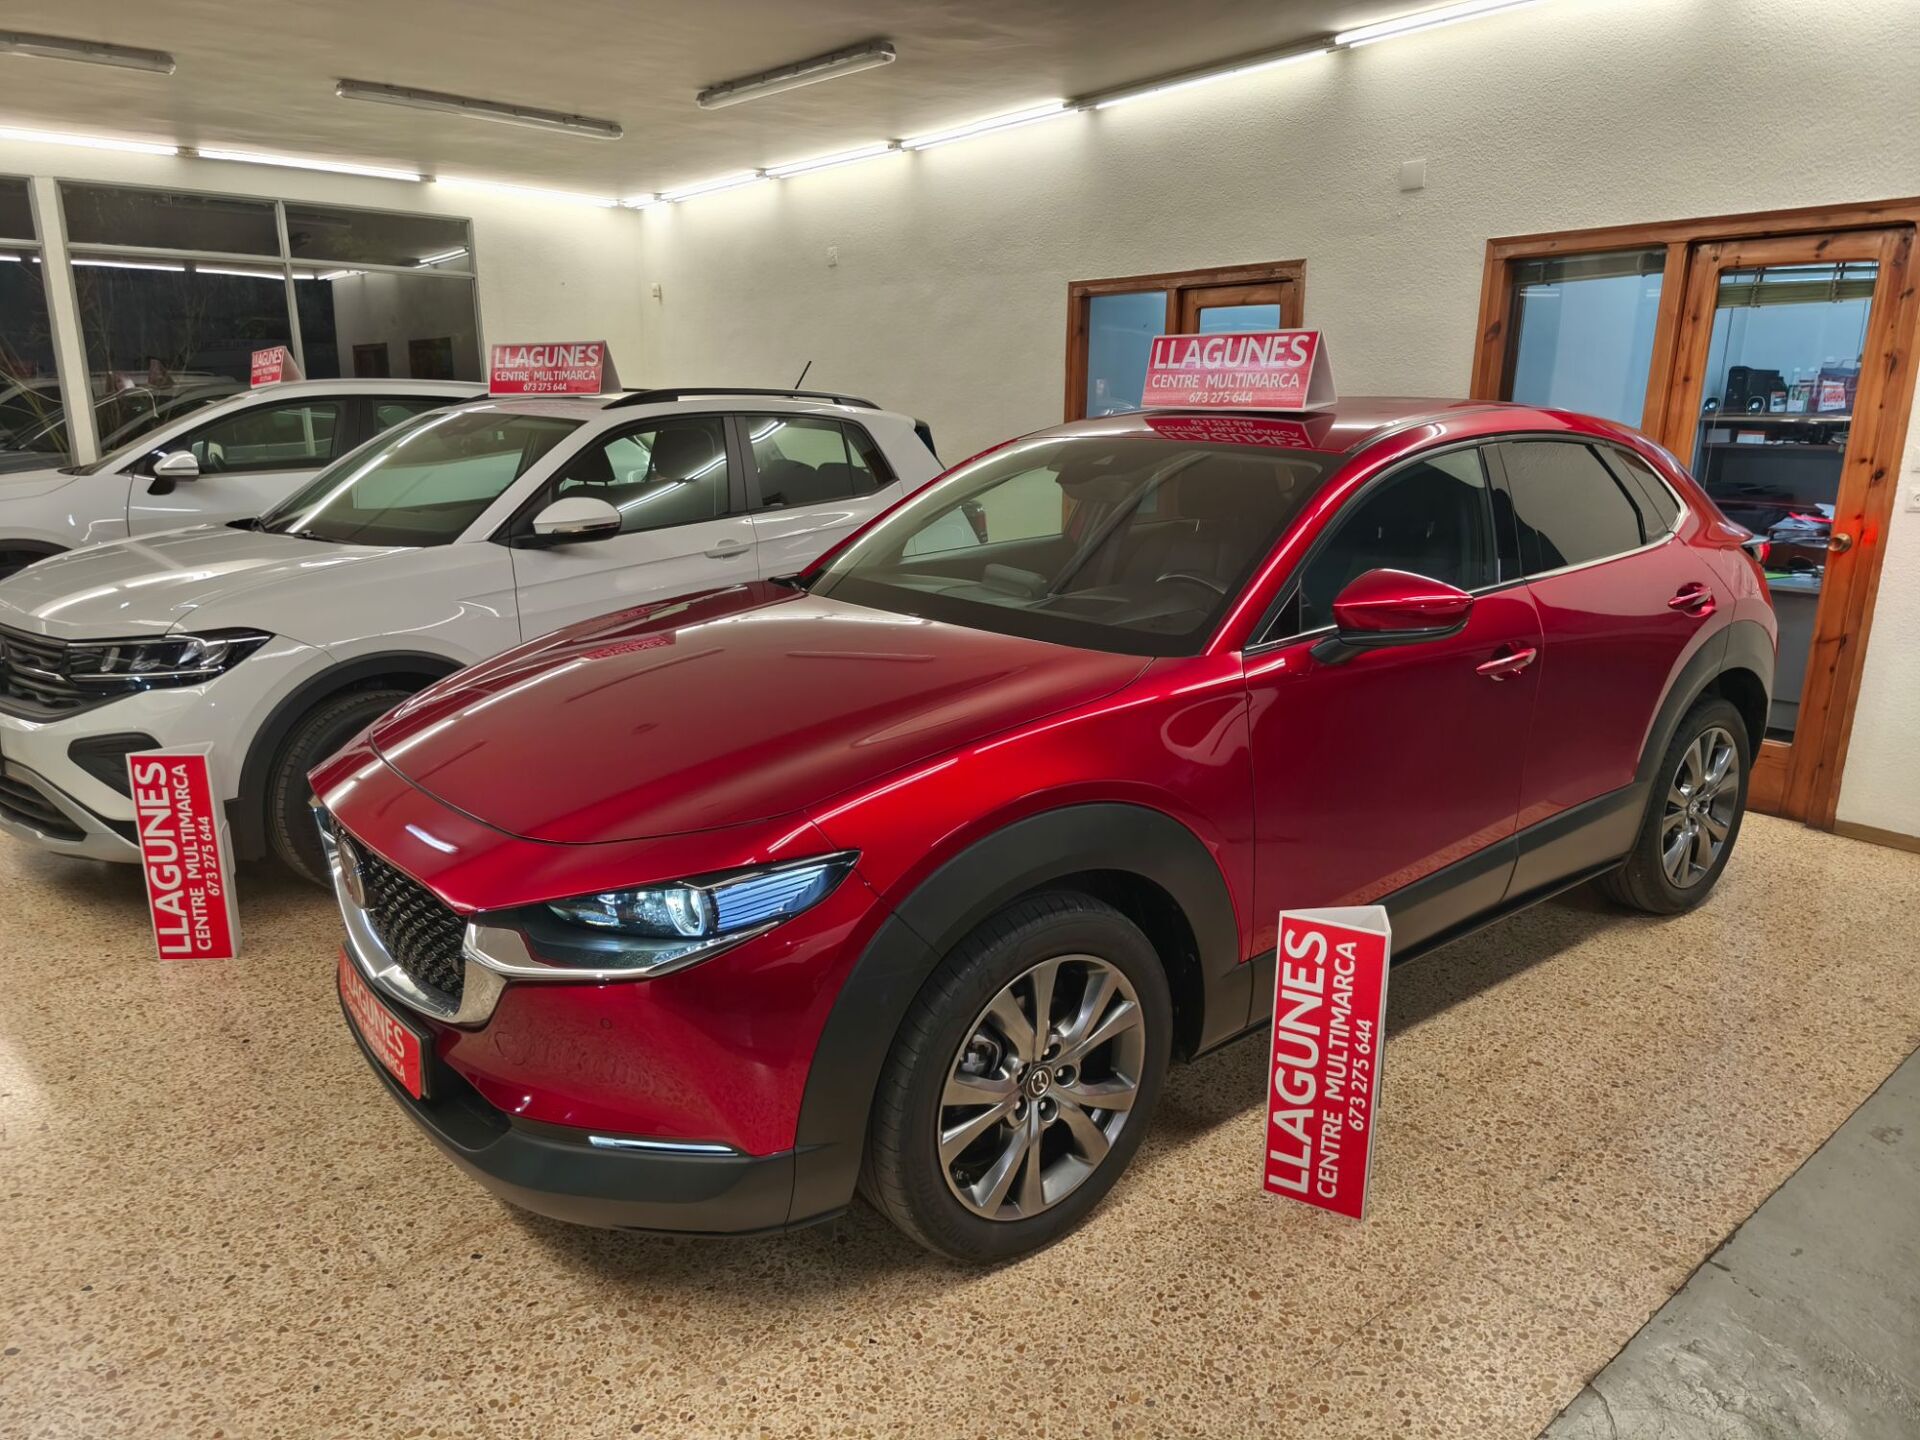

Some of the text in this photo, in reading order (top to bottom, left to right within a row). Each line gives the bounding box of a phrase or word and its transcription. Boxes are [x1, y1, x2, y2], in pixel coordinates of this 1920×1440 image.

[494, 345, 599, 369] LLAGUNES
[494, 369, 596, 381] CENTRE MULTIMARCA
[1151, 371, 1300, 389] CENTRE MULTIMARCA
[1153, 335, 1310, 370] LLAGUNES
[523, 382, 567, 392] 673 275 644
[1188, 391, 1253, 404] 673 275 644
[134, 761, 192, 954] LLAGUNES
[171, 763, 213, 951] CENTRE MULTIMARCA
[197, 816, 220, 896] 673 275 644
[1268, 928, 1328, 1195] LLAGUNES
[1316, 941, 1358, 1199] CENTRE MULTIMARCA
[1348, 1018, 1374, 1133] 673 275 644
